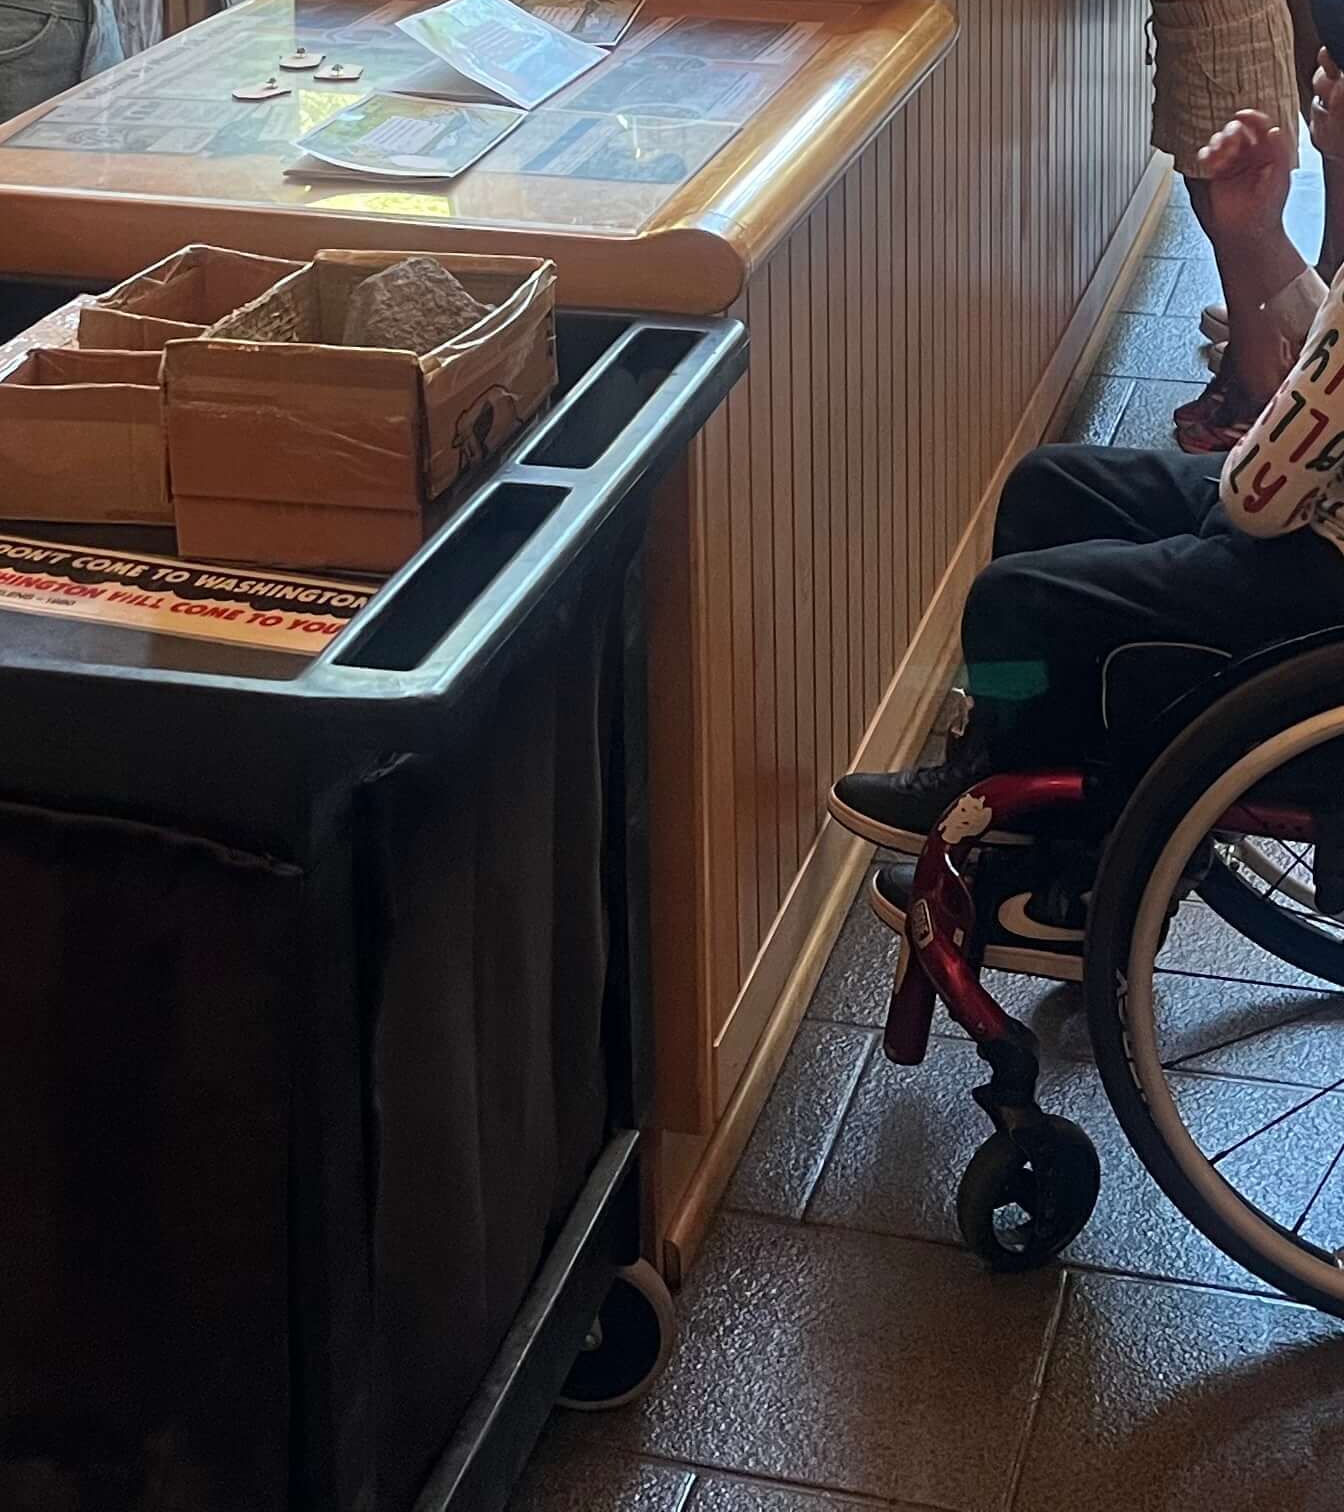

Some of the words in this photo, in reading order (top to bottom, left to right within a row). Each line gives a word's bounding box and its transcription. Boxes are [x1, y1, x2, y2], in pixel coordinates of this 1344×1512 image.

[71, 556, 149, 578] COME
[151, 567, 191, 584] TO
[193, 573, 369, 609] WASHINGTON
[107, 590, 166, 609] WILL
[170, 601, 246, 621] COME
[245, 612, 284, 628] TO
